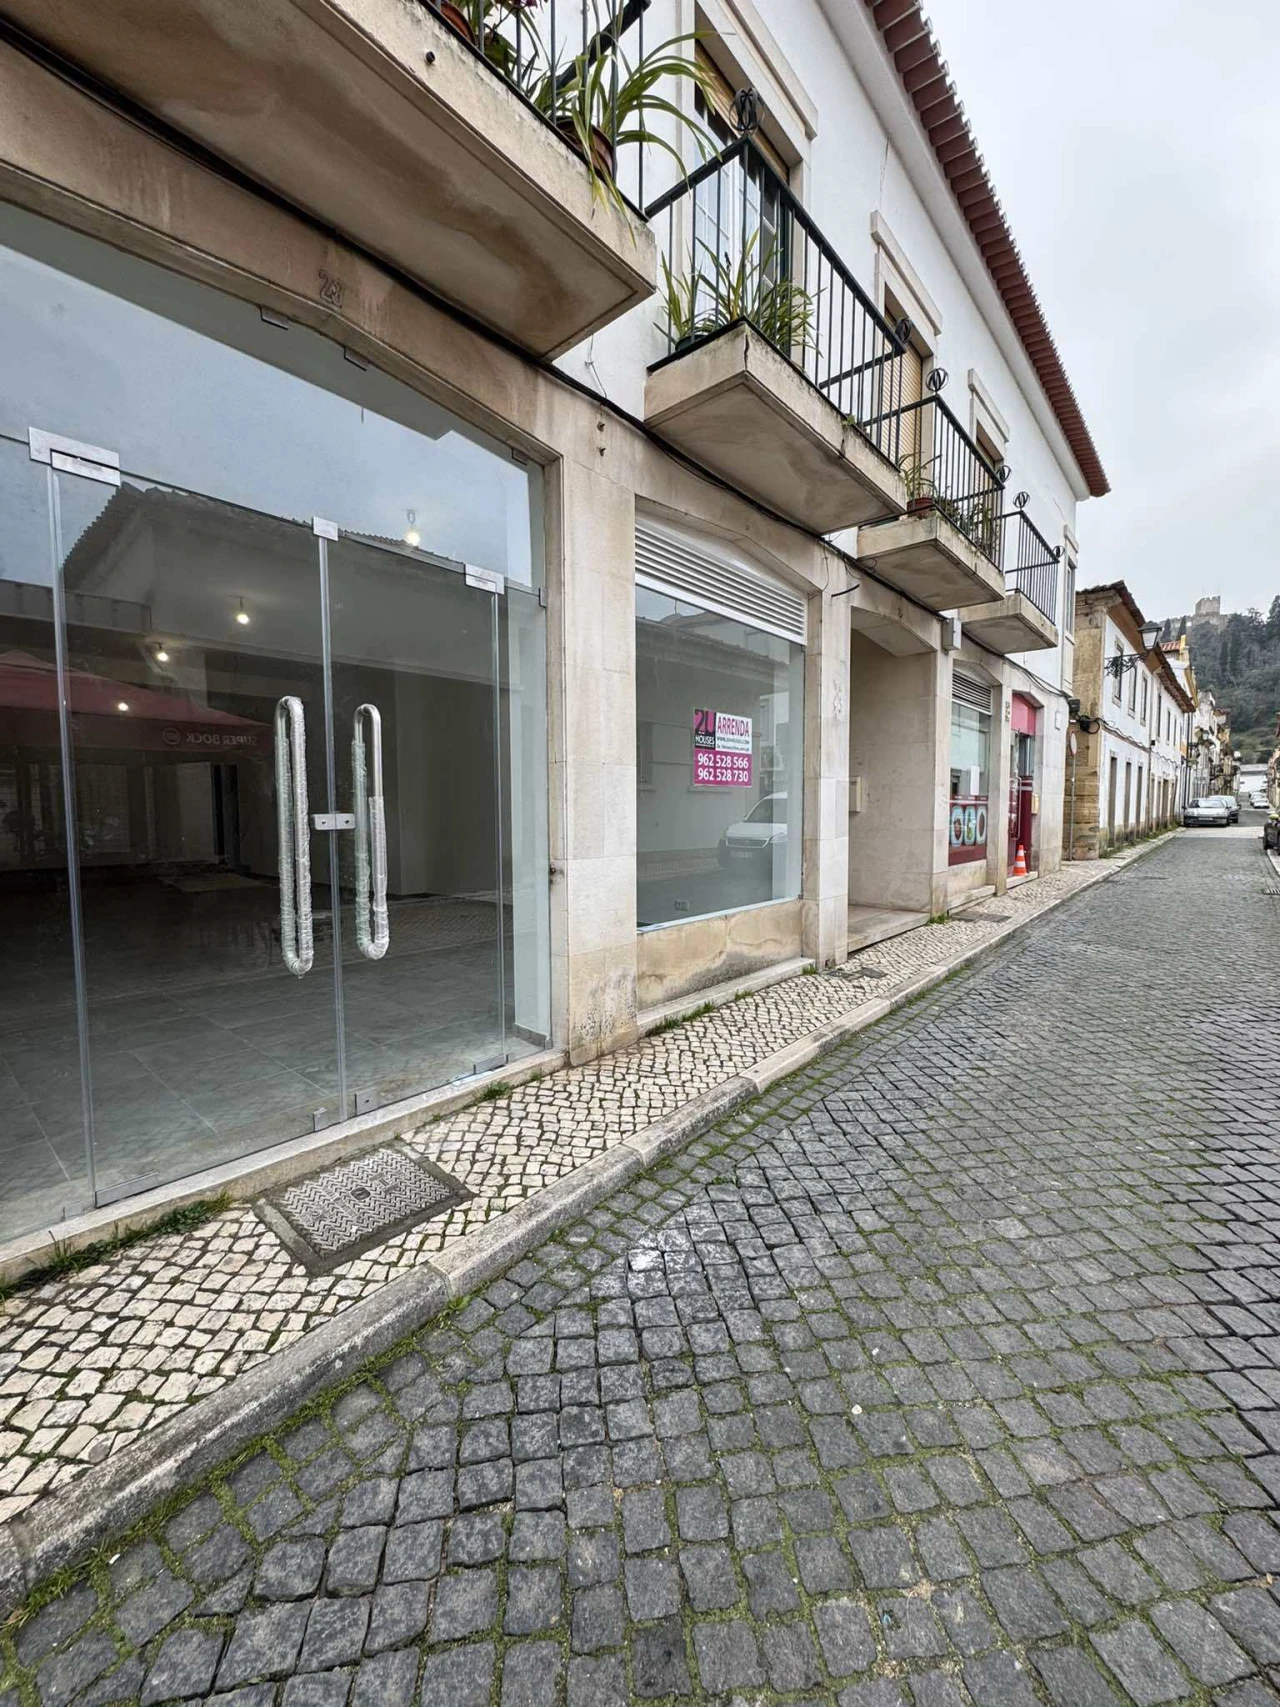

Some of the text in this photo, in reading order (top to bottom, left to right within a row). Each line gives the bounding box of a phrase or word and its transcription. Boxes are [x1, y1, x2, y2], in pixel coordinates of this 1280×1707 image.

[717, 716, 750, 738] ARRENDA
[695, 735, 715, 745] HOUSES
[698, 753, 749, 769] 962 528 566
[698, 768, 749, 782] 962 528 730
